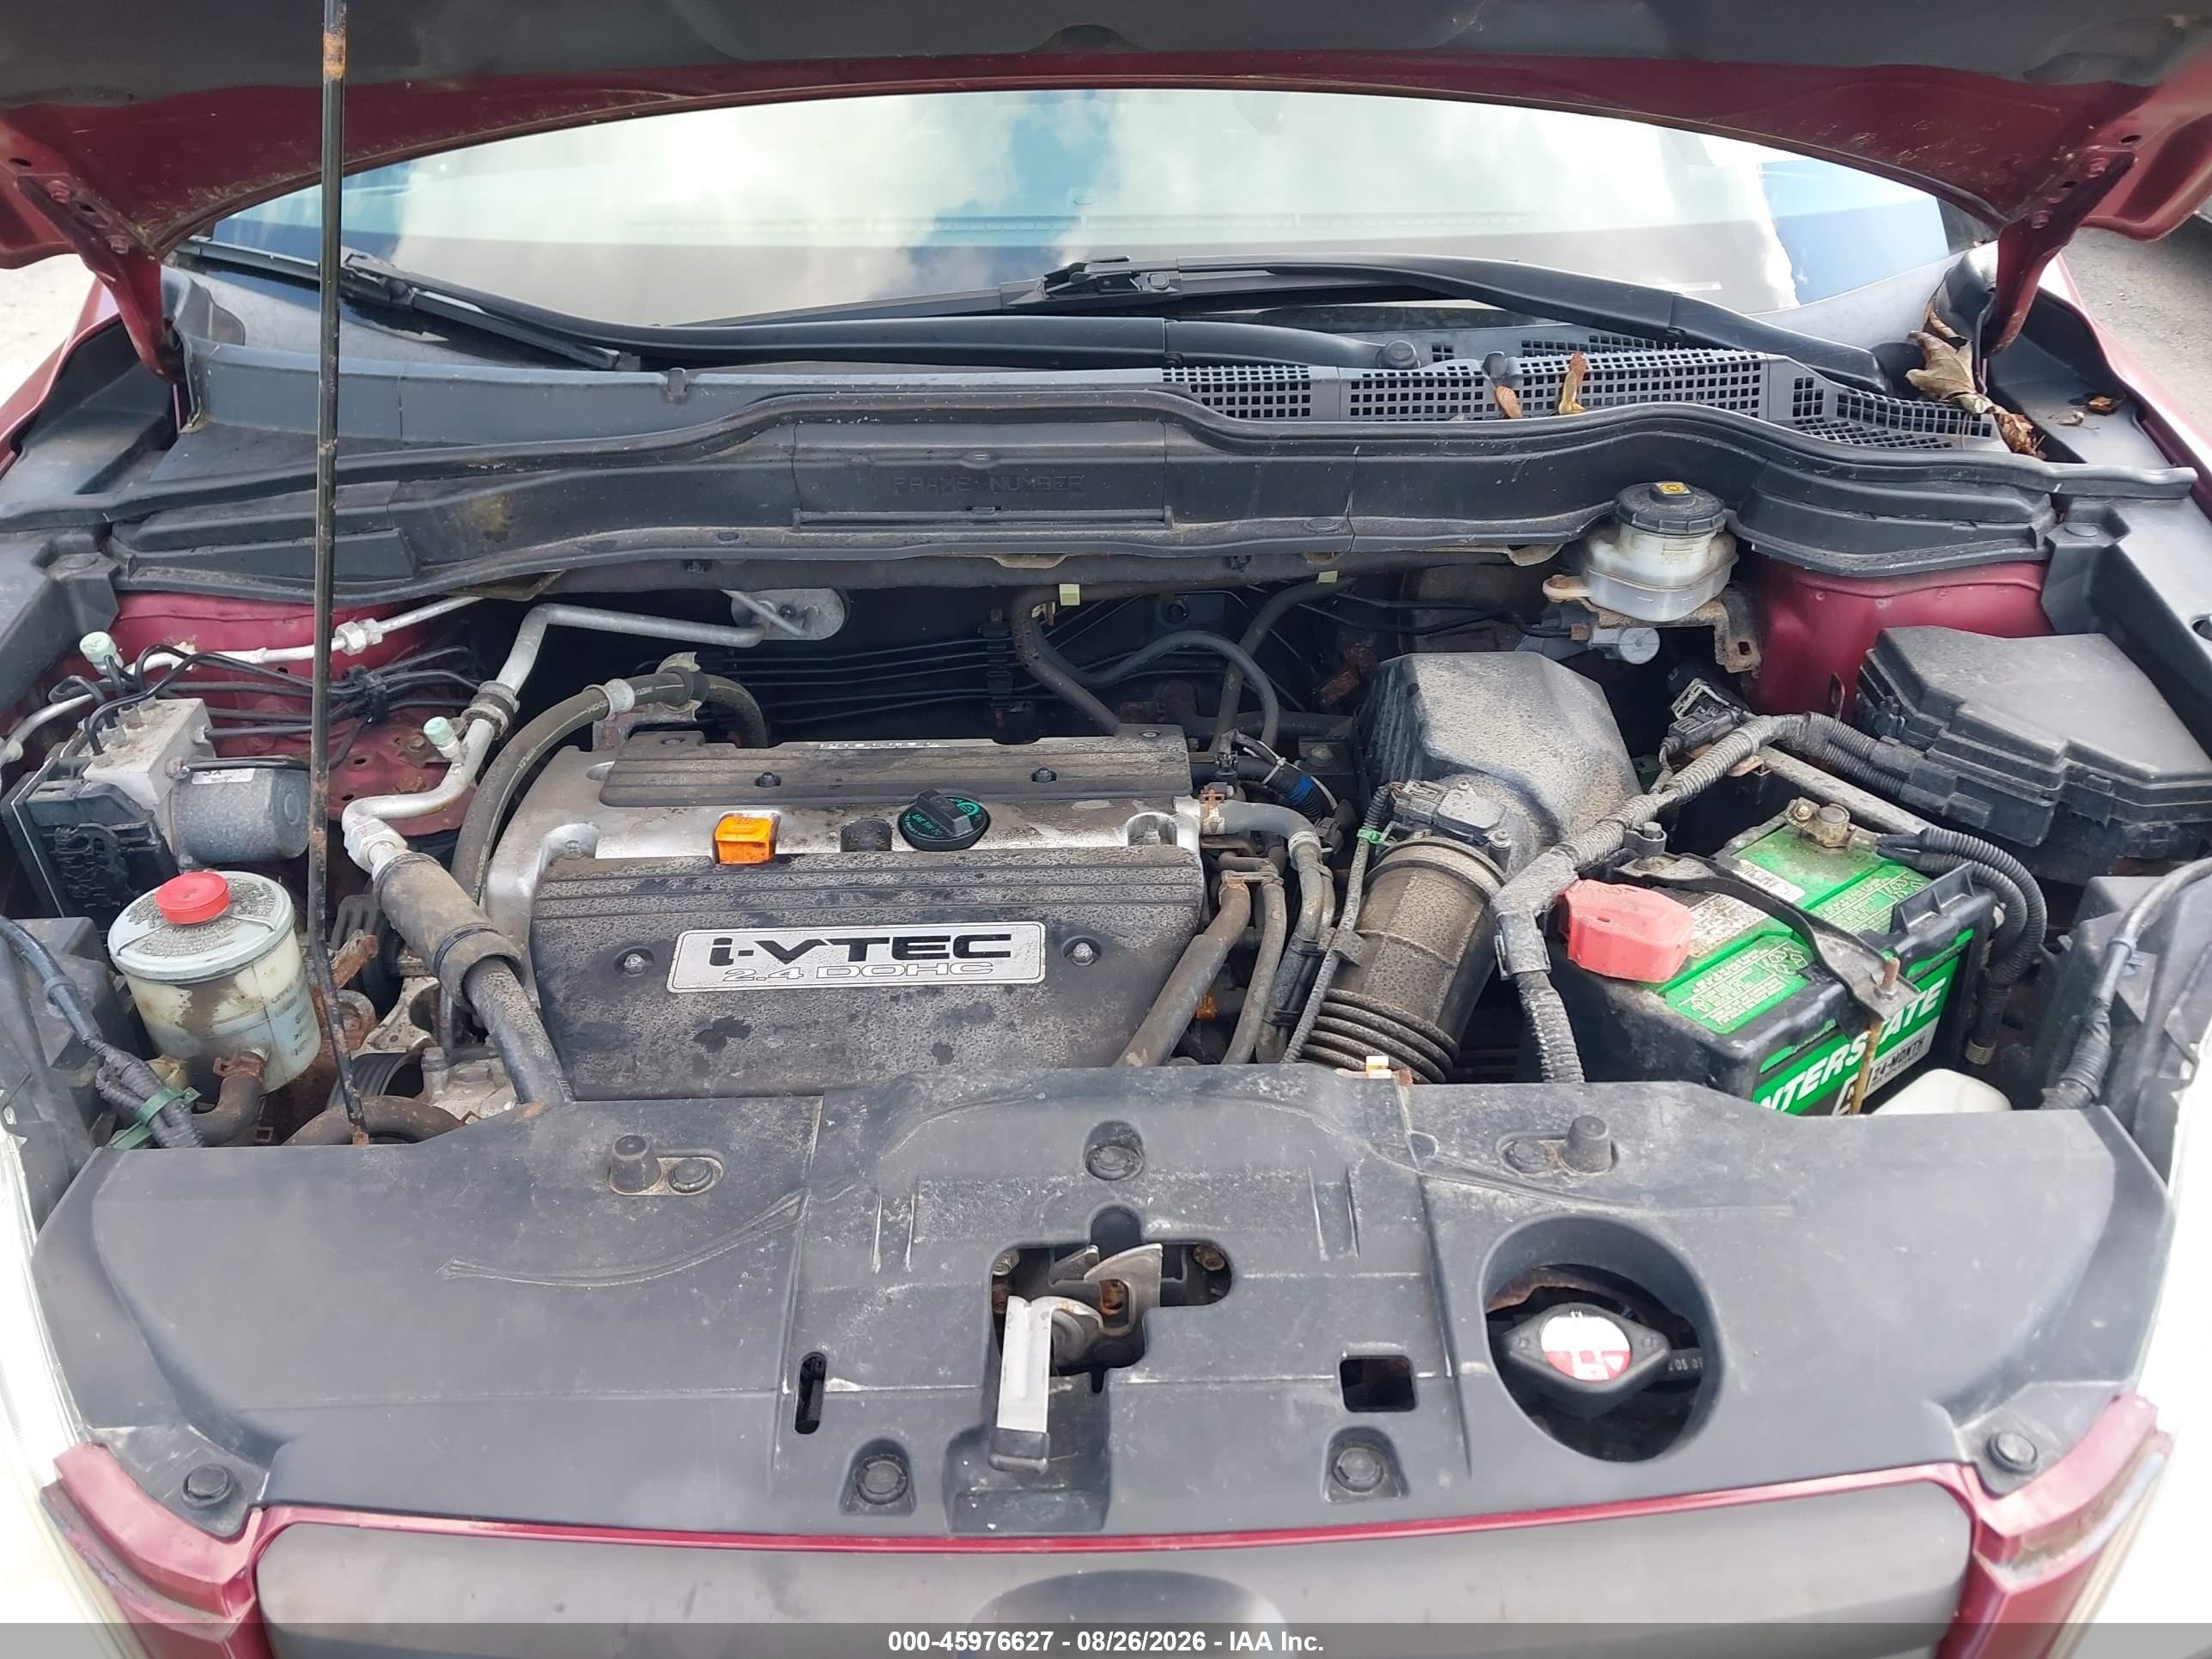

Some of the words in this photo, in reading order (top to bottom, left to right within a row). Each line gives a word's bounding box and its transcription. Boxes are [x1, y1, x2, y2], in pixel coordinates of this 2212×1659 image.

[709, 933, 1012, 966] i-VTEC
[721, 967, 805, 982] 2.4
[815, 961, 994, 979] DOHC
[1759, 976, 1948, 1112] NTERSTATE
